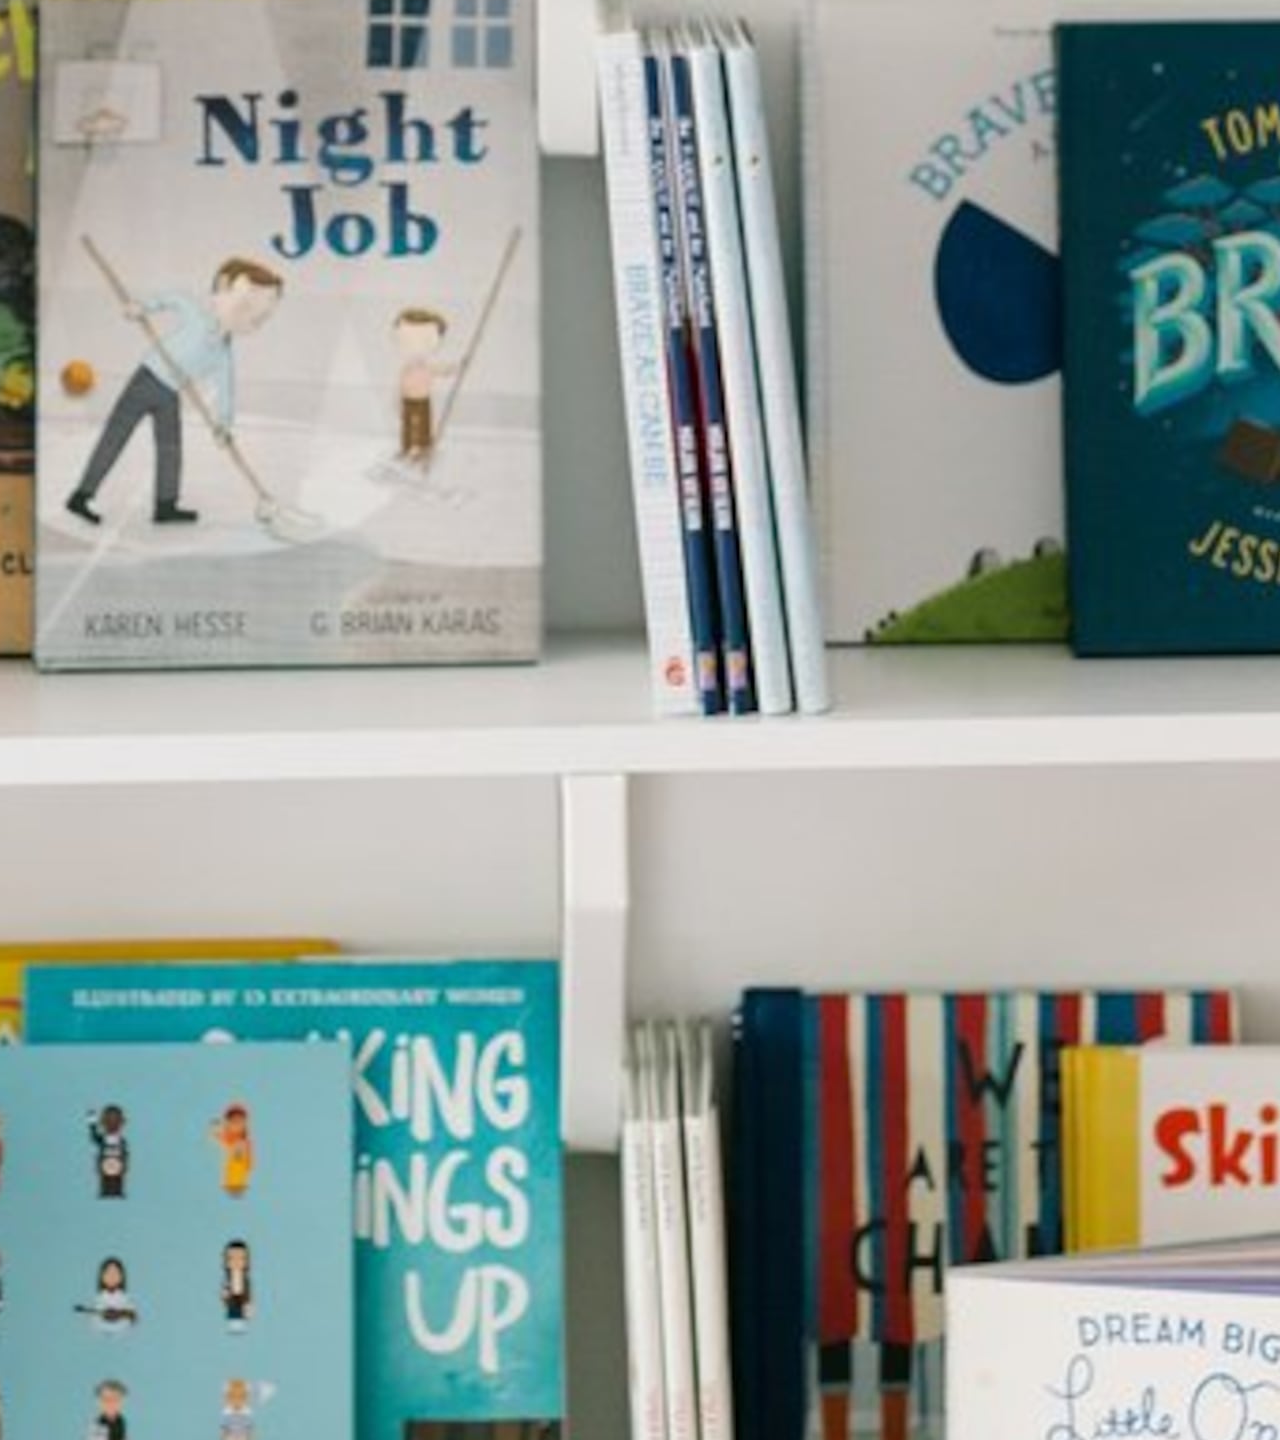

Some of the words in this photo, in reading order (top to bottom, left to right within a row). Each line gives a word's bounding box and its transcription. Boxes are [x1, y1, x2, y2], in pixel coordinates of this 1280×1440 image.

[194, 89, 489, 186] Night
[272, 181, 440, 260] Job
[82, 611, 163, 640] KAREN
[172, 610, 248, 639] HESSE
[337, 610, 418, 638] BRIAN
[419, 608, 503, 638] KARAS
[70, 986, 205, 1009] ILLUSTRATED
[209, 986, 238, 1008] BY
[269, 984, 439, 1008] EXTRAORDINARY
[443, 983, 524, 1006] WOMEN
[902, 1139, 1002, 1193] ARE
[404, 1265, 528, 1374] UP
[1077, 1312, 1207, 1349] DREAM
